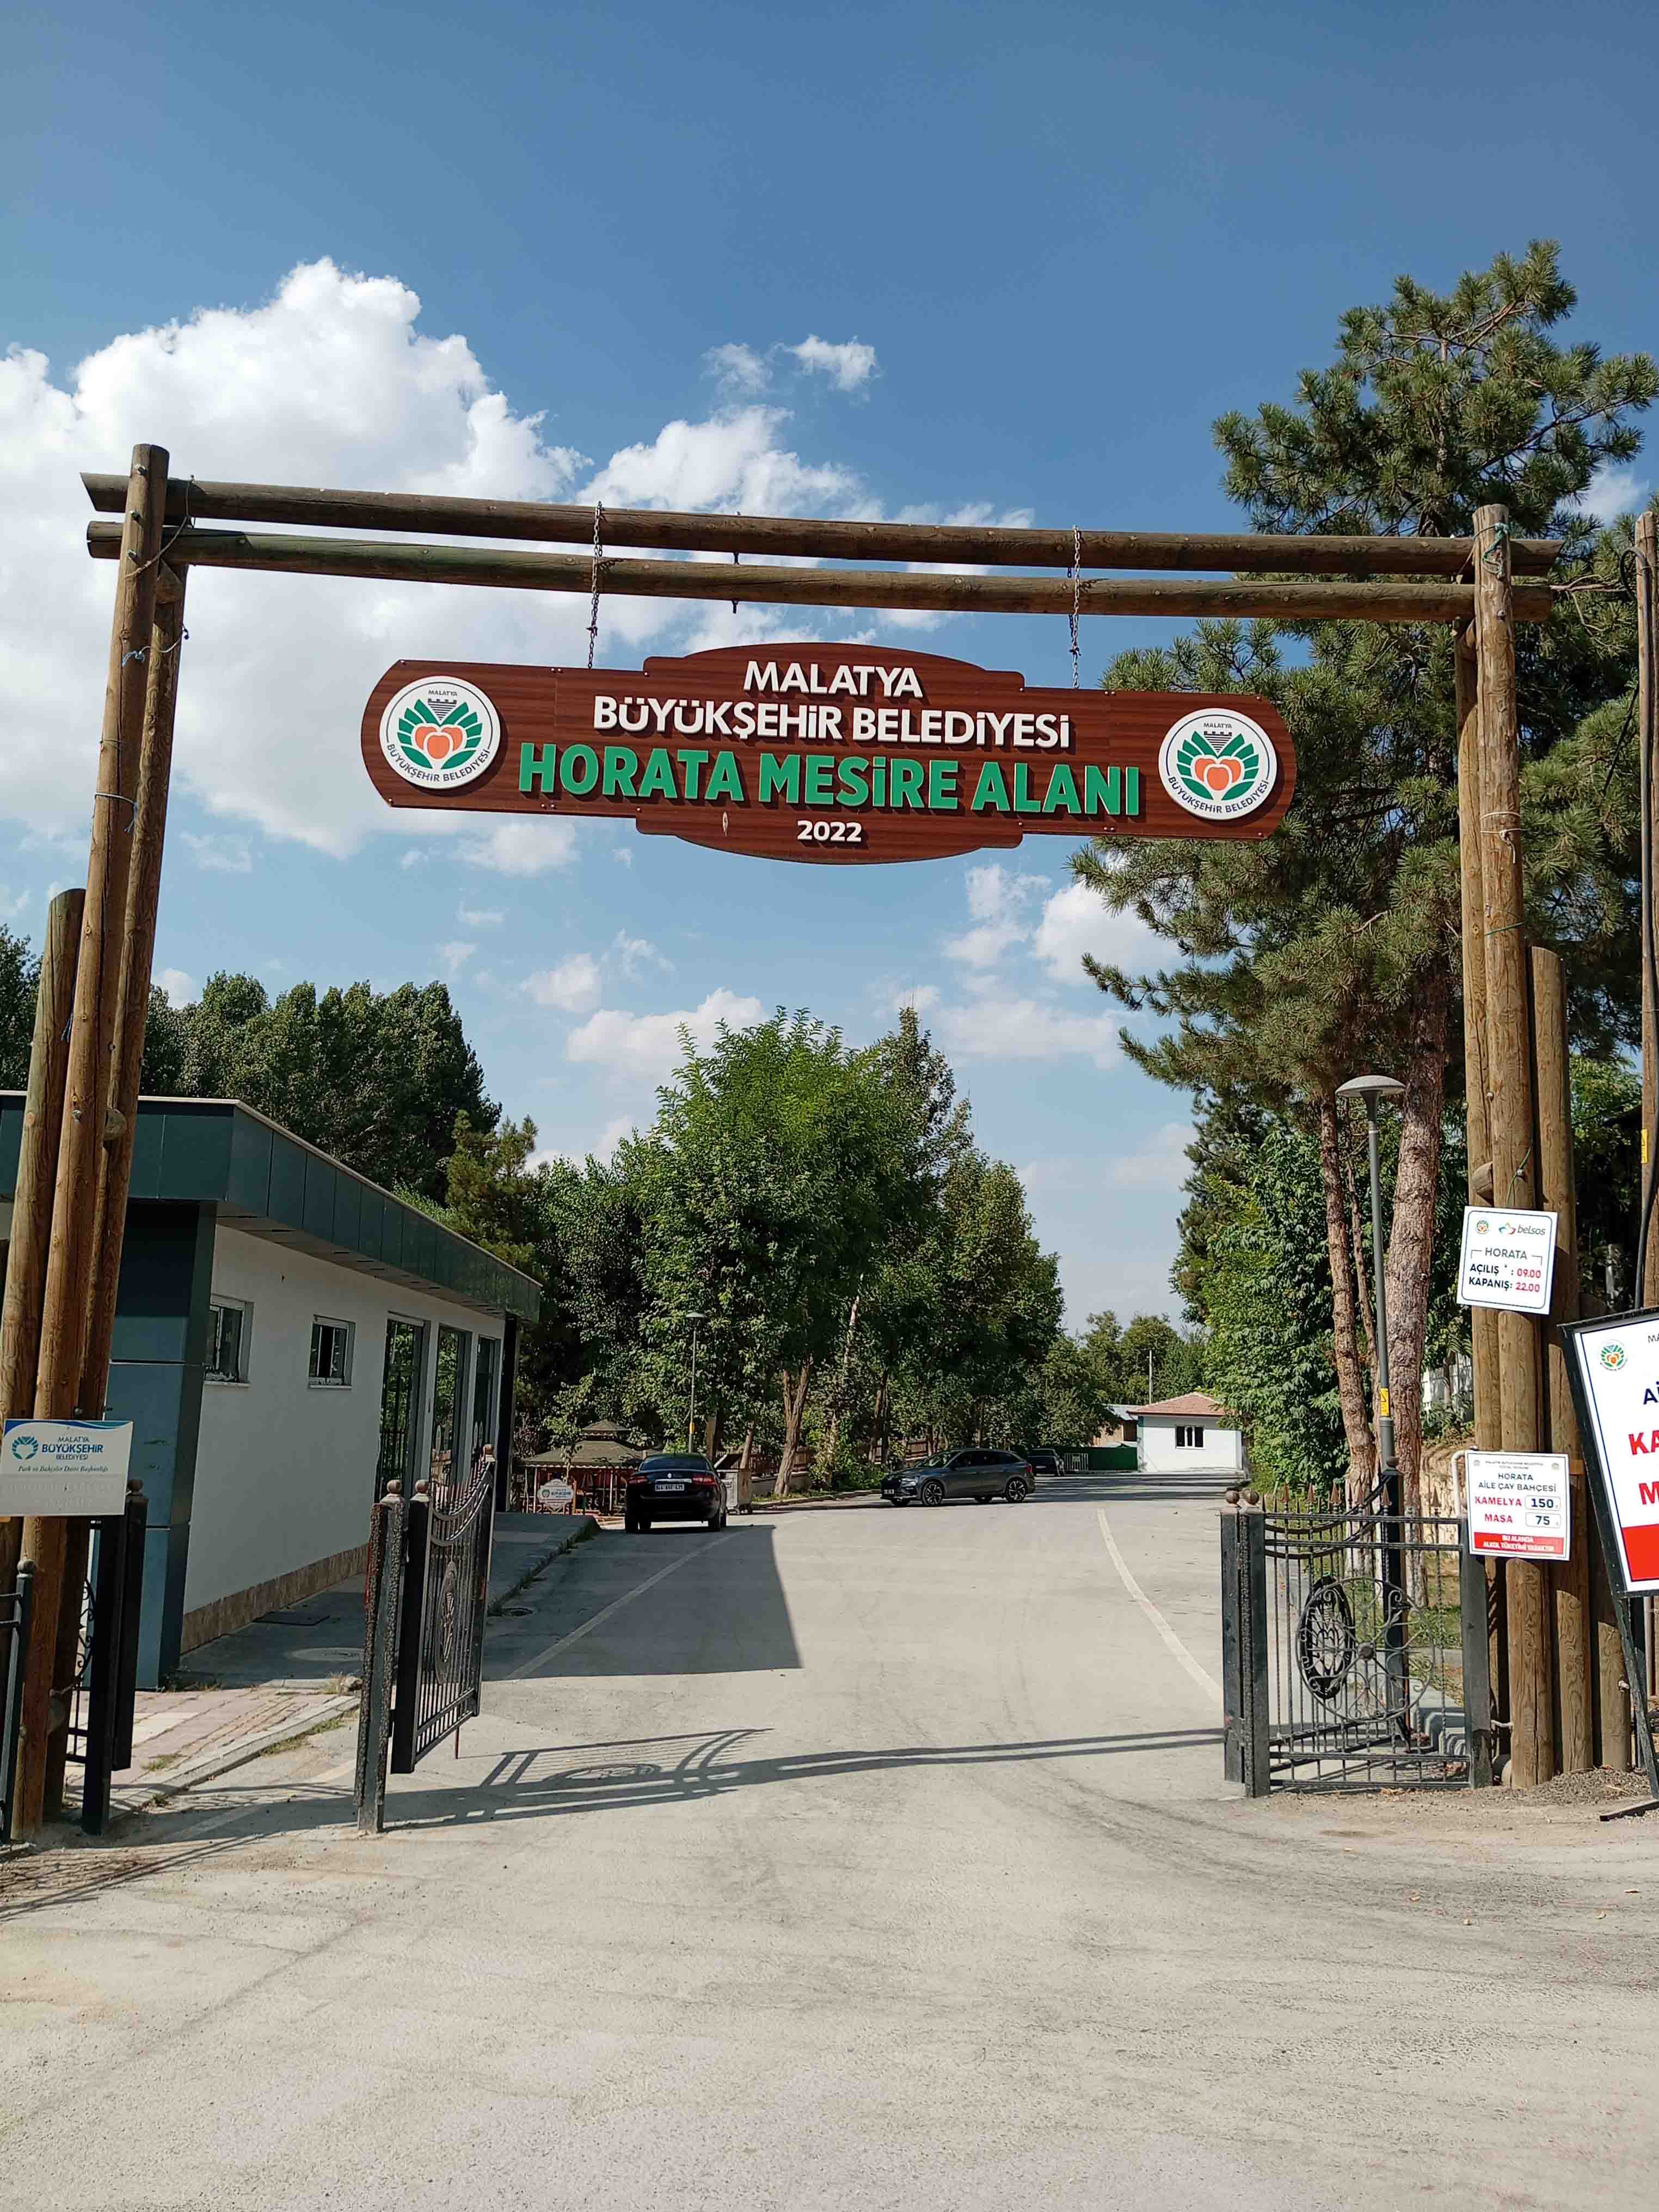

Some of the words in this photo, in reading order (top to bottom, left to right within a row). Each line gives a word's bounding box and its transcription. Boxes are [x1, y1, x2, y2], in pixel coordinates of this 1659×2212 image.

[744, 661, 923, 698] MALATYA
[594, 696, 843, 740] BÜYÜKŞEHİR
[852, 707, 1069, 748] BELEDİYESİ
[387, 744, 440, 782] BÜYÜKŞEHİR
[443, 749, 490, 782] BELEDİYESİ
[520, 744, 744, 800] HORATA
[759, 754, 959, 808] MESİRE
[972, 763, 1139, 815] ALANI
[1168, 776, 1222, 814] BÜYÜKŞEHİR
[1225, 781, 1269, 813] BELEDİYESİ
[797, 820, 862, 841] 2022
[1517, 1225, 1546, 1235] belsos
[1485, 1247, 1528, 1260] HORATA
[1470, 1264, 1500, 1276] AÇILIŞ
[1517, 1268, 1541, 1279] 09.00
[1515, 1282, 1540, 1293] 22.00
[1478, 1480, 1496, 1489] AİLE
[1517, 1483, 1557, 1492] BAHÇESİ
[1474, 1496, 1522, 1507] KAMELYA
[1531, 1498, 1554, 1508] 150
[1484, 1513, 1513, 1523] MASA
[1535, 1515, 1550, 1525] 75
